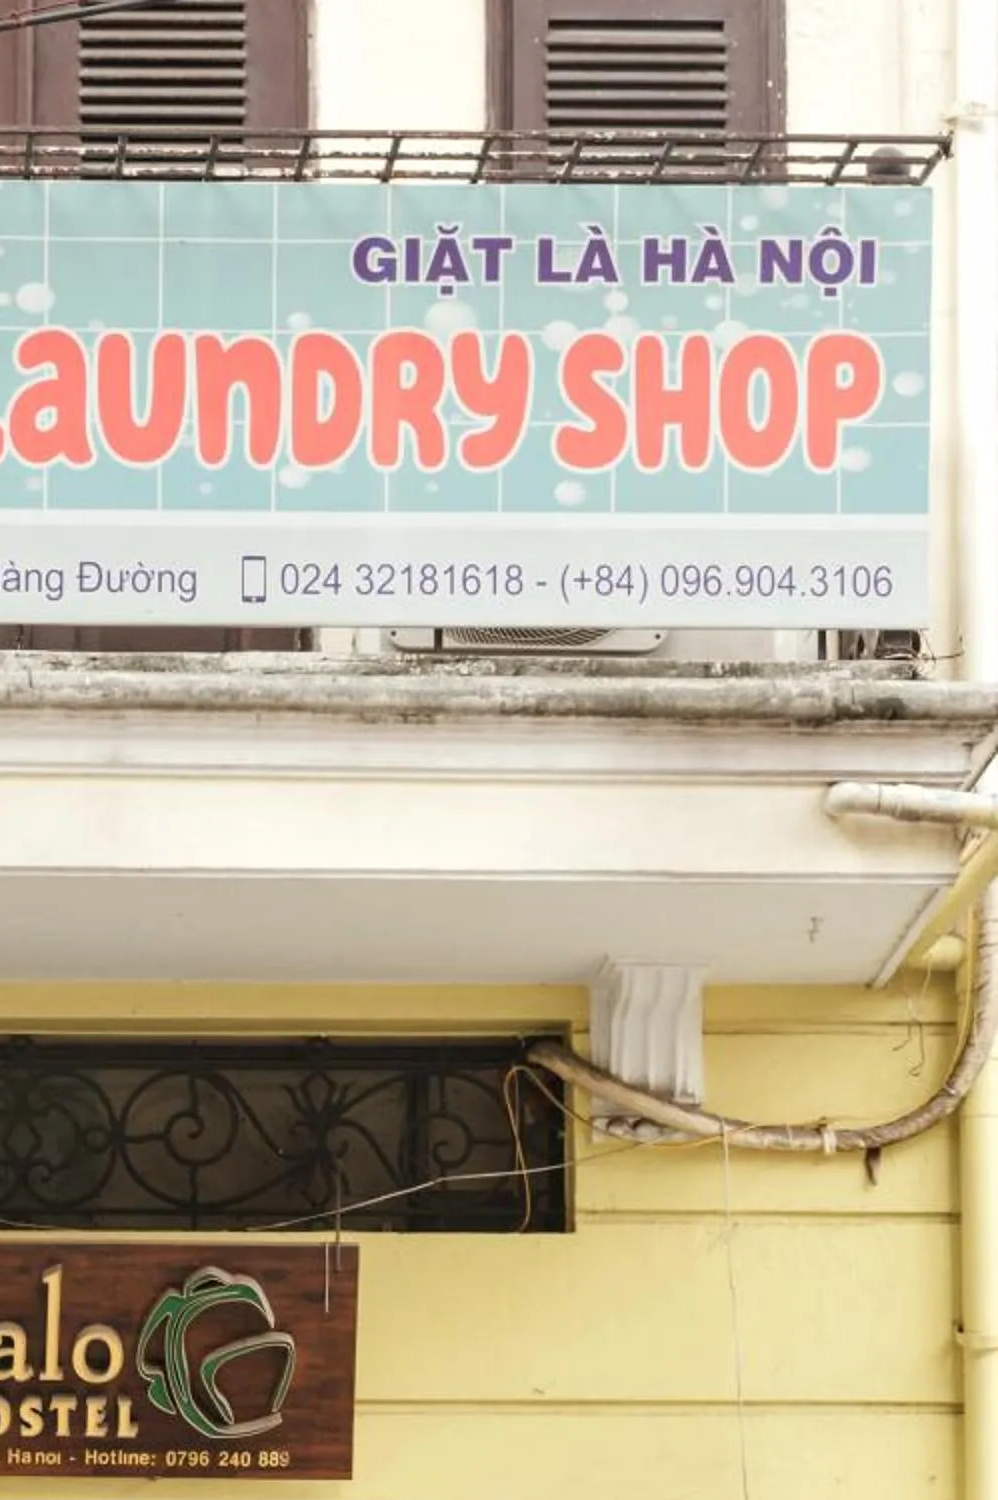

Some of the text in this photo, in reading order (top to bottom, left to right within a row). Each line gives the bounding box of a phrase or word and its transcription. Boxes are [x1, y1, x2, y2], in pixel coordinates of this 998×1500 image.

[352, 225, 877, 296] GIẶT LÀ HÀ NỘI
[554, 334, 881, 470] SHOP
[76, 560, 198, 603] Đường
[280, 564, 342, 597] 024
[355, 564, 524, 597] 32181618
[560, 563, 649, 604] (+84)
[660, 564, 893, 599] 096.904.3106
[165, 1450, 210, 1468] 0796
[219, 1451, 252, 1468] 240
[258, 1451, 291, 1468] 889
